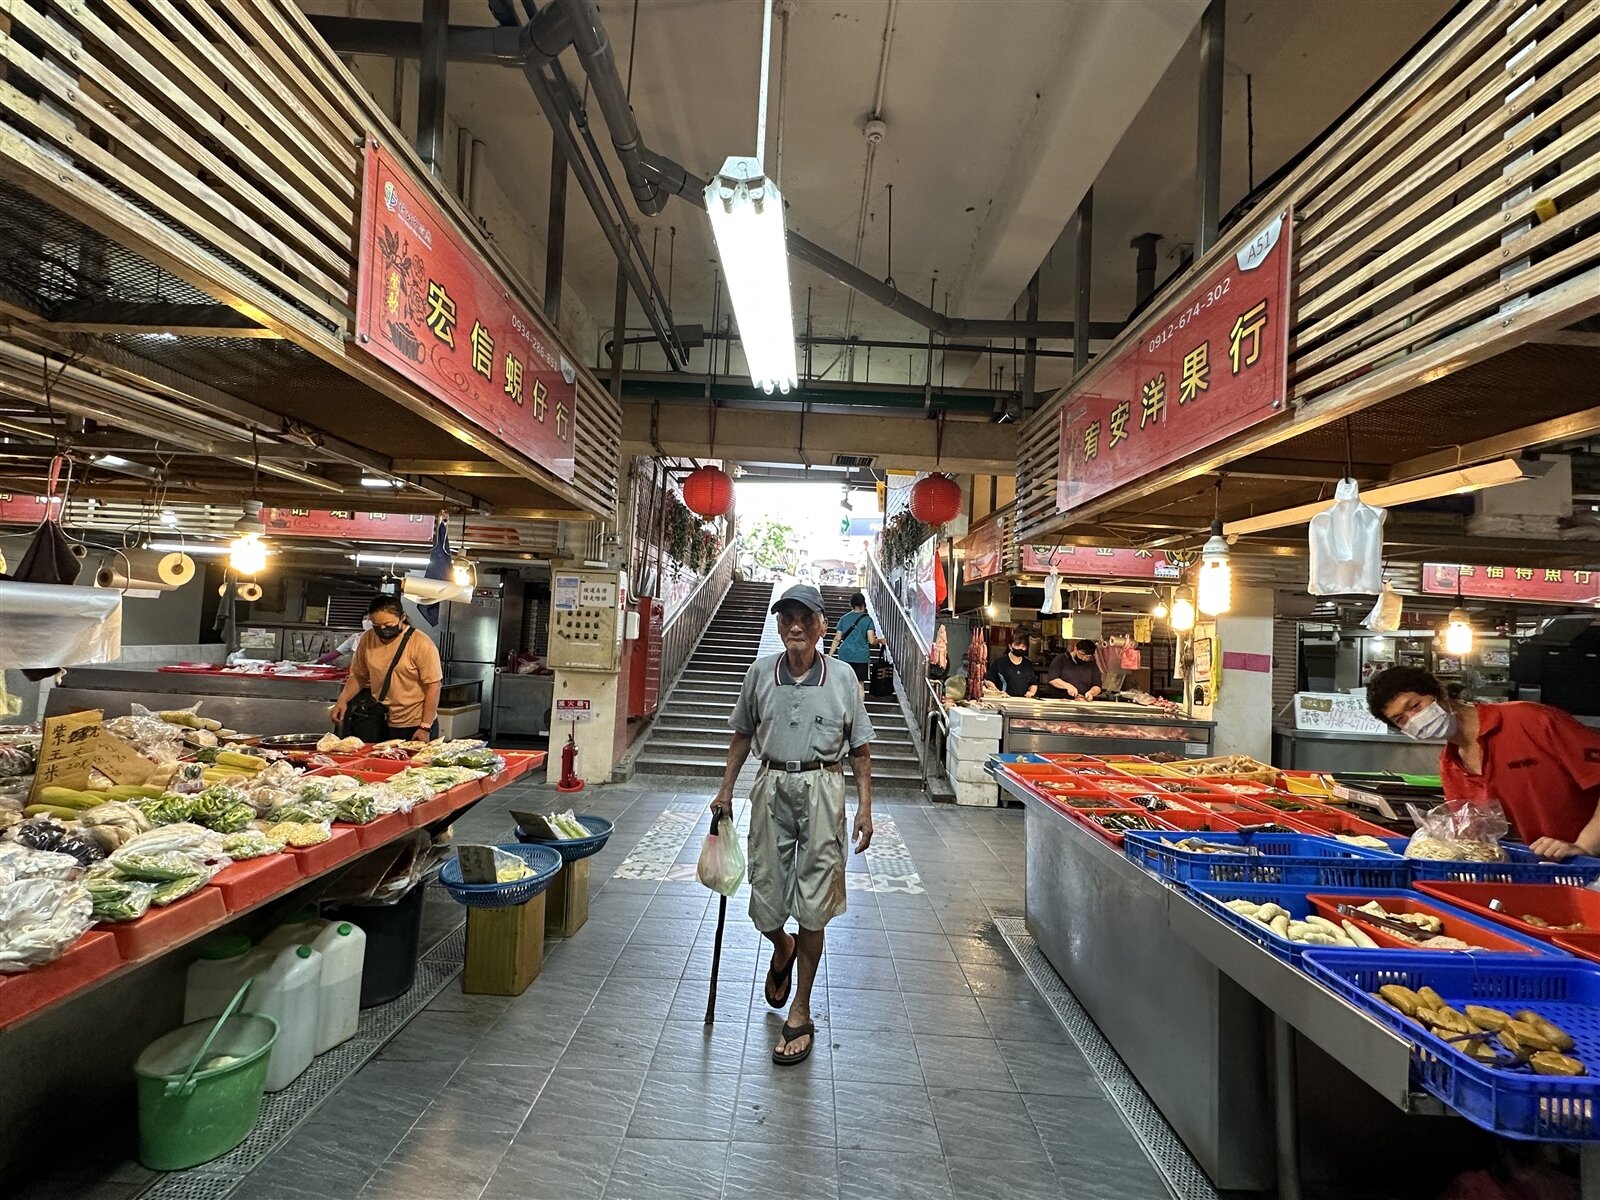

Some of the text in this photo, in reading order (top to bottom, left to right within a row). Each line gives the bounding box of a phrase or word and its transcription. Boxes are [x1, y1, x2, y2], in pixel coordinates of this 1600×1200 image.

[1248, 231, 1271, 263] A51
[427, 280, 569, 441] 宏信蜆仔行
[1149, 277, 1231, 353] 0912-674-302
[1084, 300, 1267, 462] 宥安洋果行
